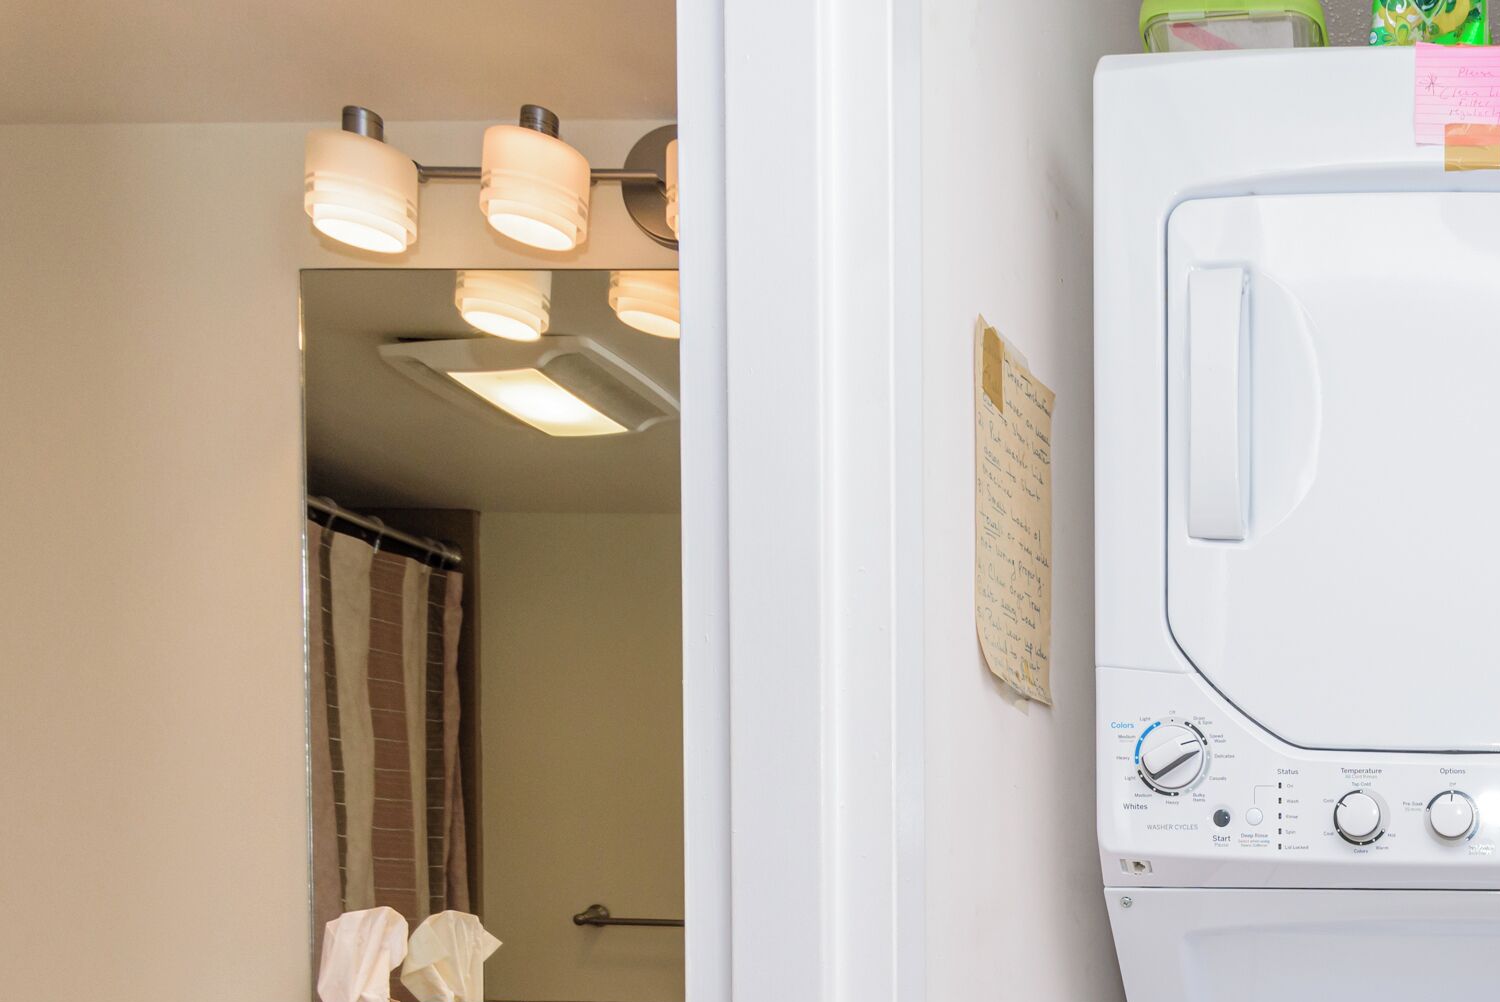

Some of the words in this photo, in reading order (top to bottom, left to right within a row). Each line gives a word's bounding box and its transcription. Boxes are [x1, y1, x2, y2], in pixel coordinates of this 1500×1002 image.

[1111, 721, 1135, 729] Colors
[1341, 767, 1382, 775] Temperature
[1439, 767, 1466, 775] Options
[1212, 834, 1231, 843] Start
